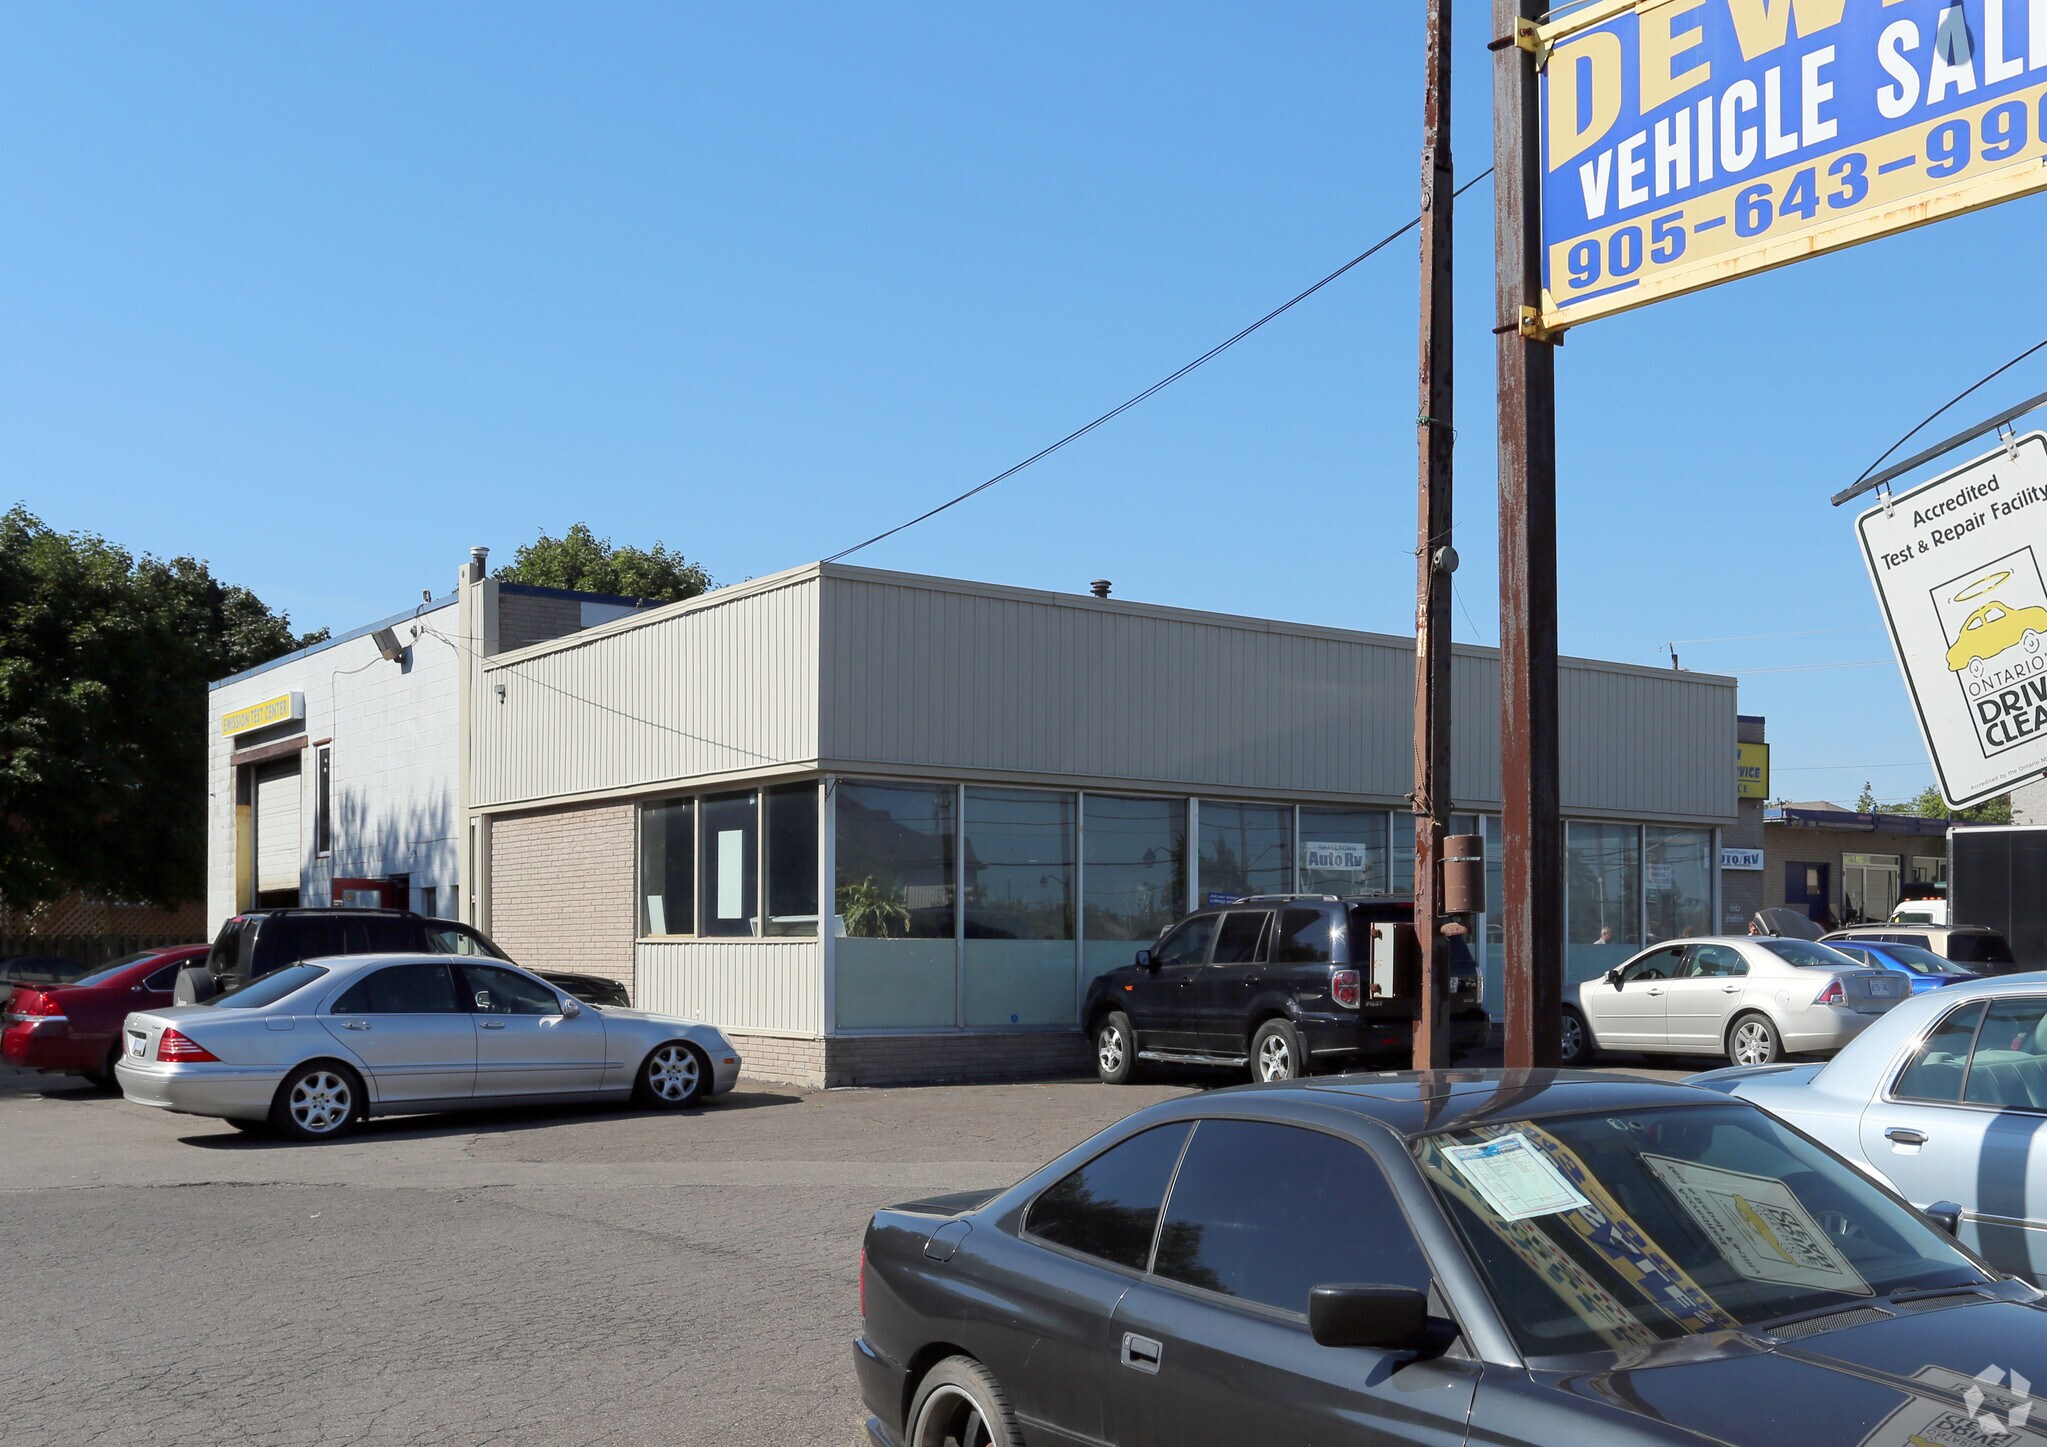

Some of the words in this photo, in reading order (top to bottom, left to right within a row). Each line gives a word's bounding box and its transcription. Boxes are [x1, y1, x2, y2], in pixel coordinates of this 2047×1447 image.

[1579, 45, 1838, 220] VEHICLE
[1881, 543, 1915, 571] Test
[1918, 539, 1930, 554] &
[1931, 512, 1986, 547] Repair
[1990, 482, 2047, 520] Facility
[1912, 474, 2000, 528] Accredited
[223, 712, 249, 732] EMISSION
[251, 707, 263, 724] TEST
[265, 699, 287, 720] CENTER
[1308, 851, 1343, 866] Auto
